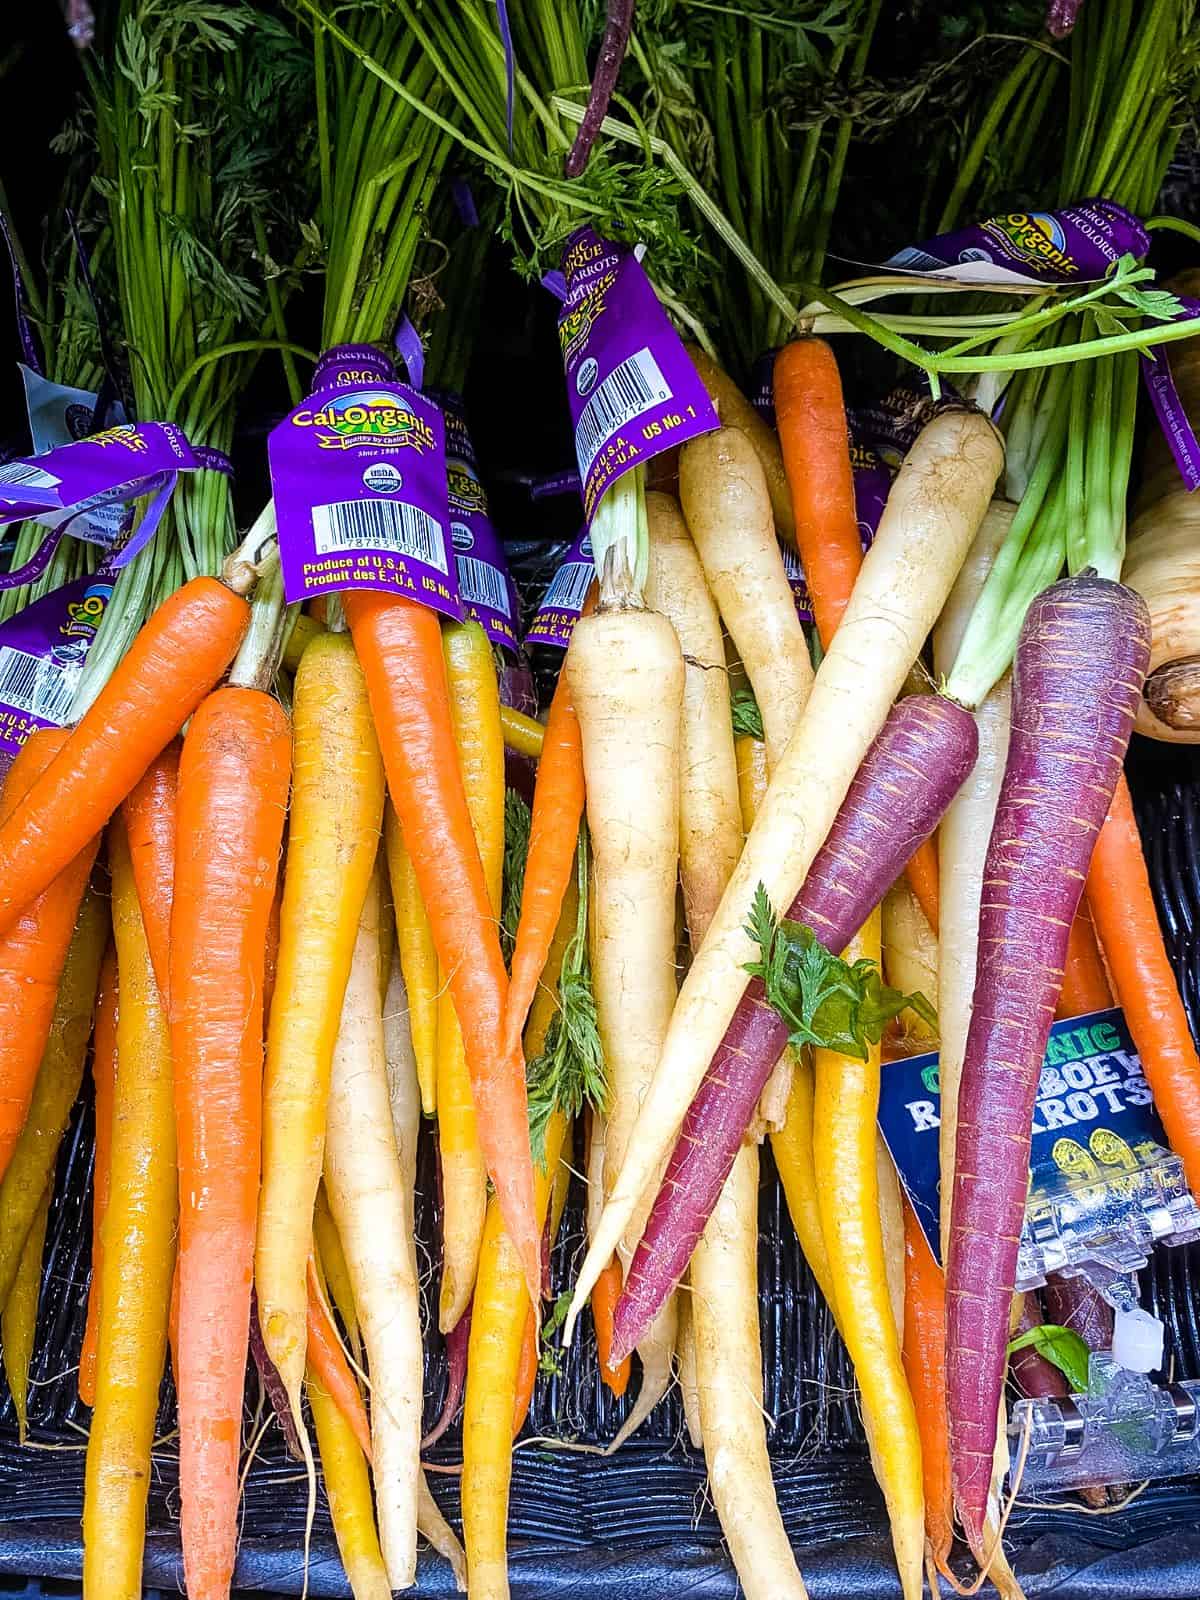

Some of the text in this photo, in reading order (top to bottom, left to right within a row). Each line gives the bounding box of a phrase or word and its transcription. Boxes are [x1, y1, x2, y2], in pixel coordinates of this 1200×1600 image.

[1007, 213, 1080, 274] Organic
[571, 254, 619, 289] ARROTS
[658, 390, 666, 400] 0
[292, 405, 434, 441] Cal-Organic
[642, 422, 662, 440] US
[661, 413, 687, 430] No.
[686, 405, 697, 418] 1
[370, 469, 394, 477] USDA
[303, 555, 410, 576] Produce of U.S.A.
[304, 570, 350, 589] Produit
[353, 569, 376, 581] des
[378, 568, 417, 591] É.-U.A.
[422, 576, 436, 592] US
[551, 612, 577, 627] U.S.A
